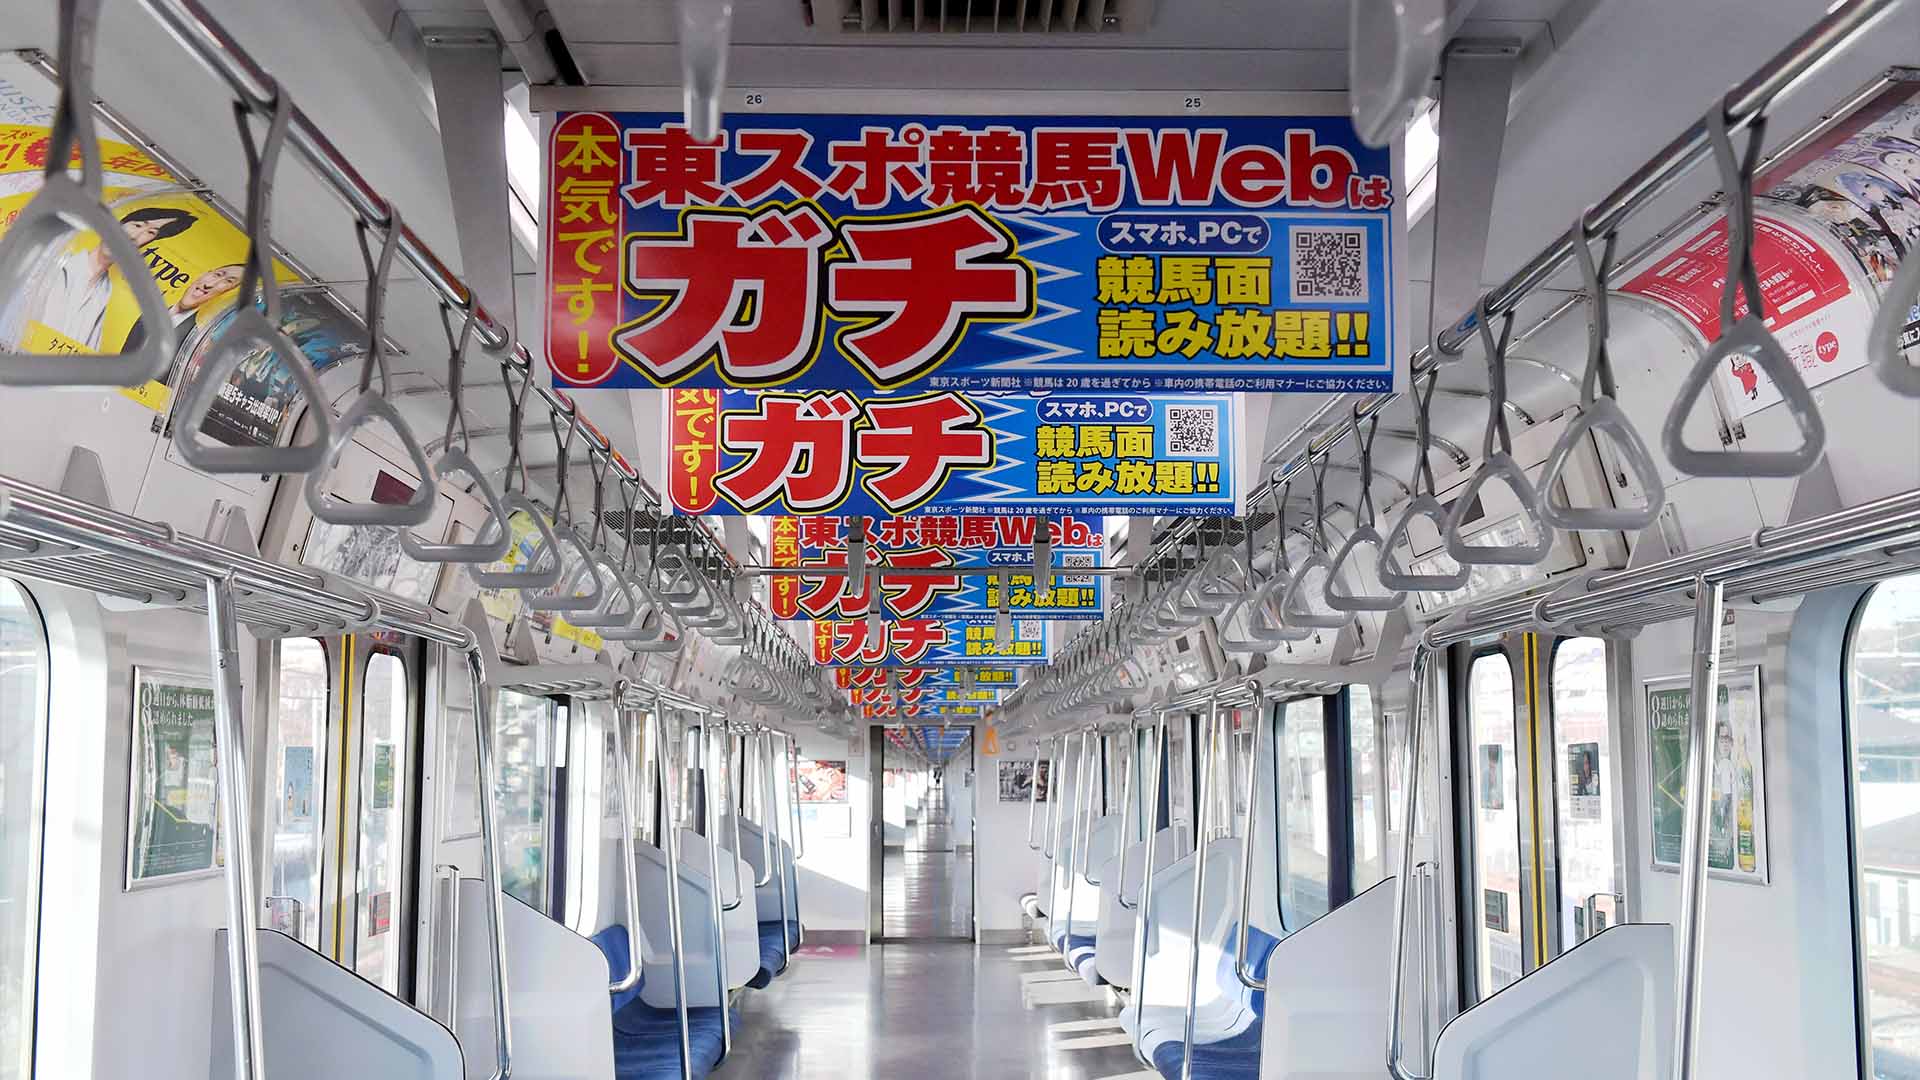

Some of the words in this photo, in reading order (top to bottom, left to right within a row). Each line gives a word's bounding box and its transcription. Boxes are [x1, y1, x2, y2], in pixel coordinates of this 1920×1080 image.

[745, 94, 763, 105] 26
[1184, 97, 1202, 108] 25
[623, 122, 1393, 210] 東スポ競馬Webは
[555, 125, 618, 373] 本気です!
[1109, 220, 1263, 246] スマホ、PCで
[143, 246, 190, 289] type
[1096, 256, 1272, 305] 競馬面
[612, 202, 1035, 387] ガチ
[1096, 310, 1371, 360] 読み放題!!
[1818, 338, 1838, 356] type
[929, 378, 1022, 389] 東京スポーツ新聞社
[1066, 379, 1079, 388] 20
[1080, 378, 1152, 389] 歳を過ぎてから
[1044, 400, 1147, 419] スマホ、PCで
[713, 391, 994, 513] ガチ
[1034, 424, 1155, 459] 競馬面
[1034, 460, 1221, 496] 読み放題!!
